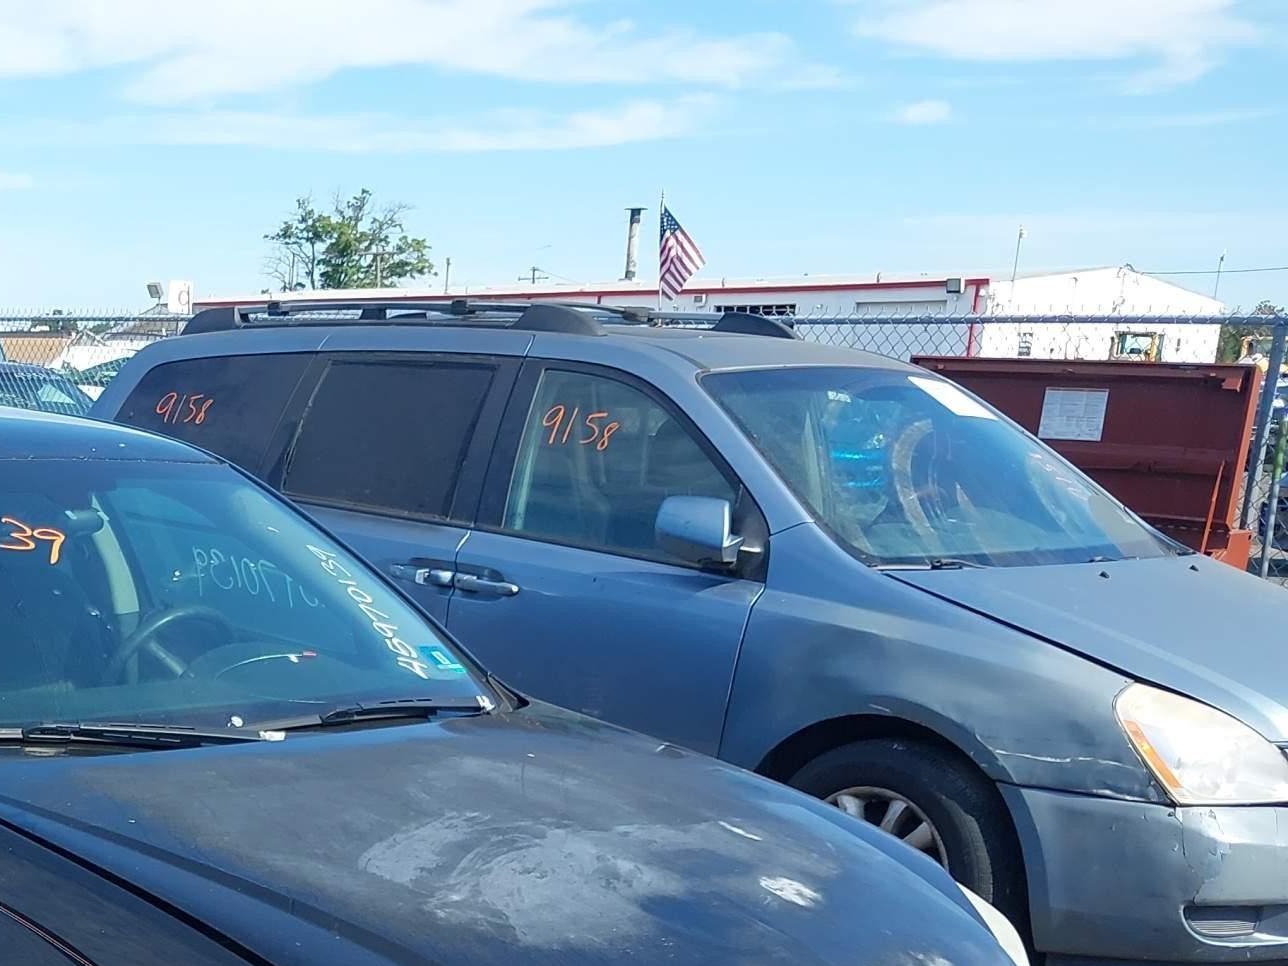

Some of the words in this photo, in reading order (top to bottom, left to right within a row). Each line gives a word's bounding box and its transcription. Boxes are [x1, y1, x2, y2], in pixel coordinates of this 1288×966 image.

[156, 392, 213, 425] 9158
[543, 405, 620, 451] 9158
[306, 544, 430, 680] 45970139
